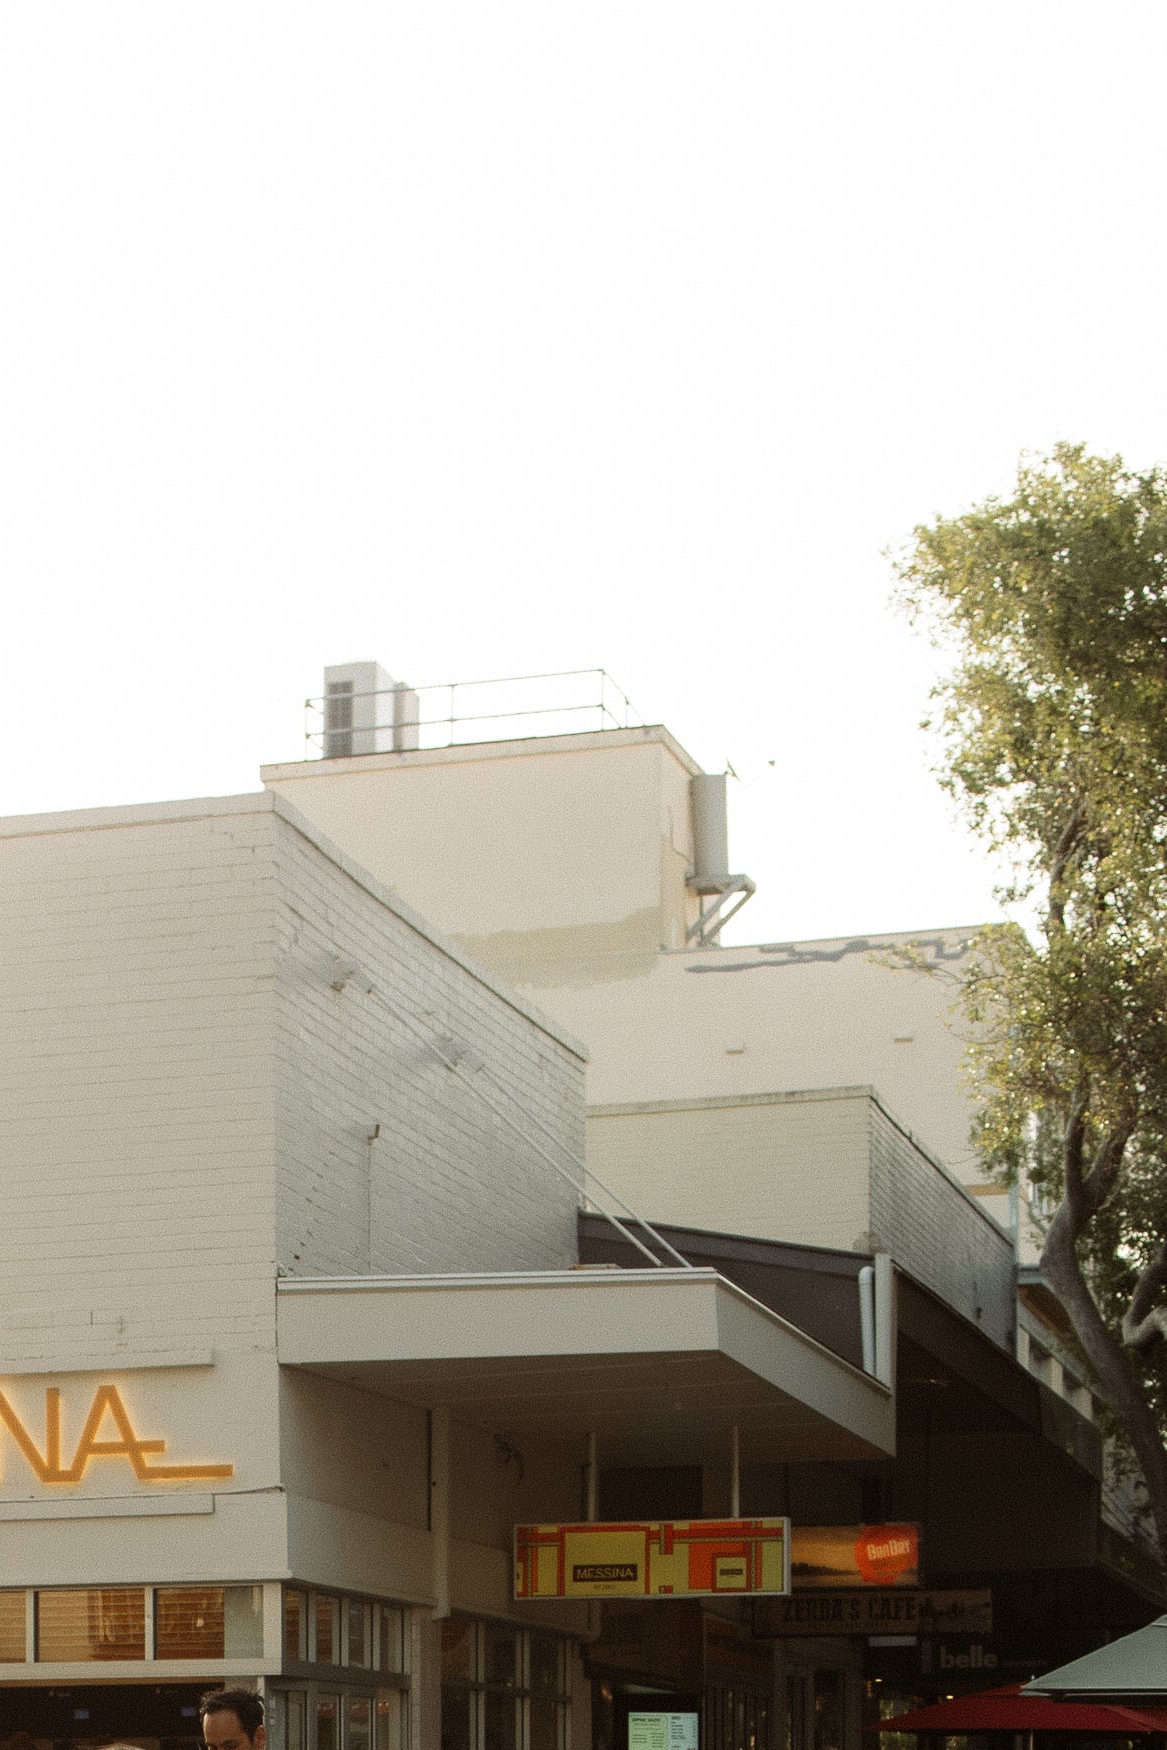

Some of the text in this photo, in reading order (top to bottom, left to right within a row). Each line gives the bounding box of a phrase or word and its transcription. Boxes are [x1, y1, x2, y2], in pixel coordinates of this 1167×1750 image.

[576, 1567, 635, 1579] MESSINA
[868, 1596, 916, 1620] CAFE
[940, 1645, 999, 1668] belle
